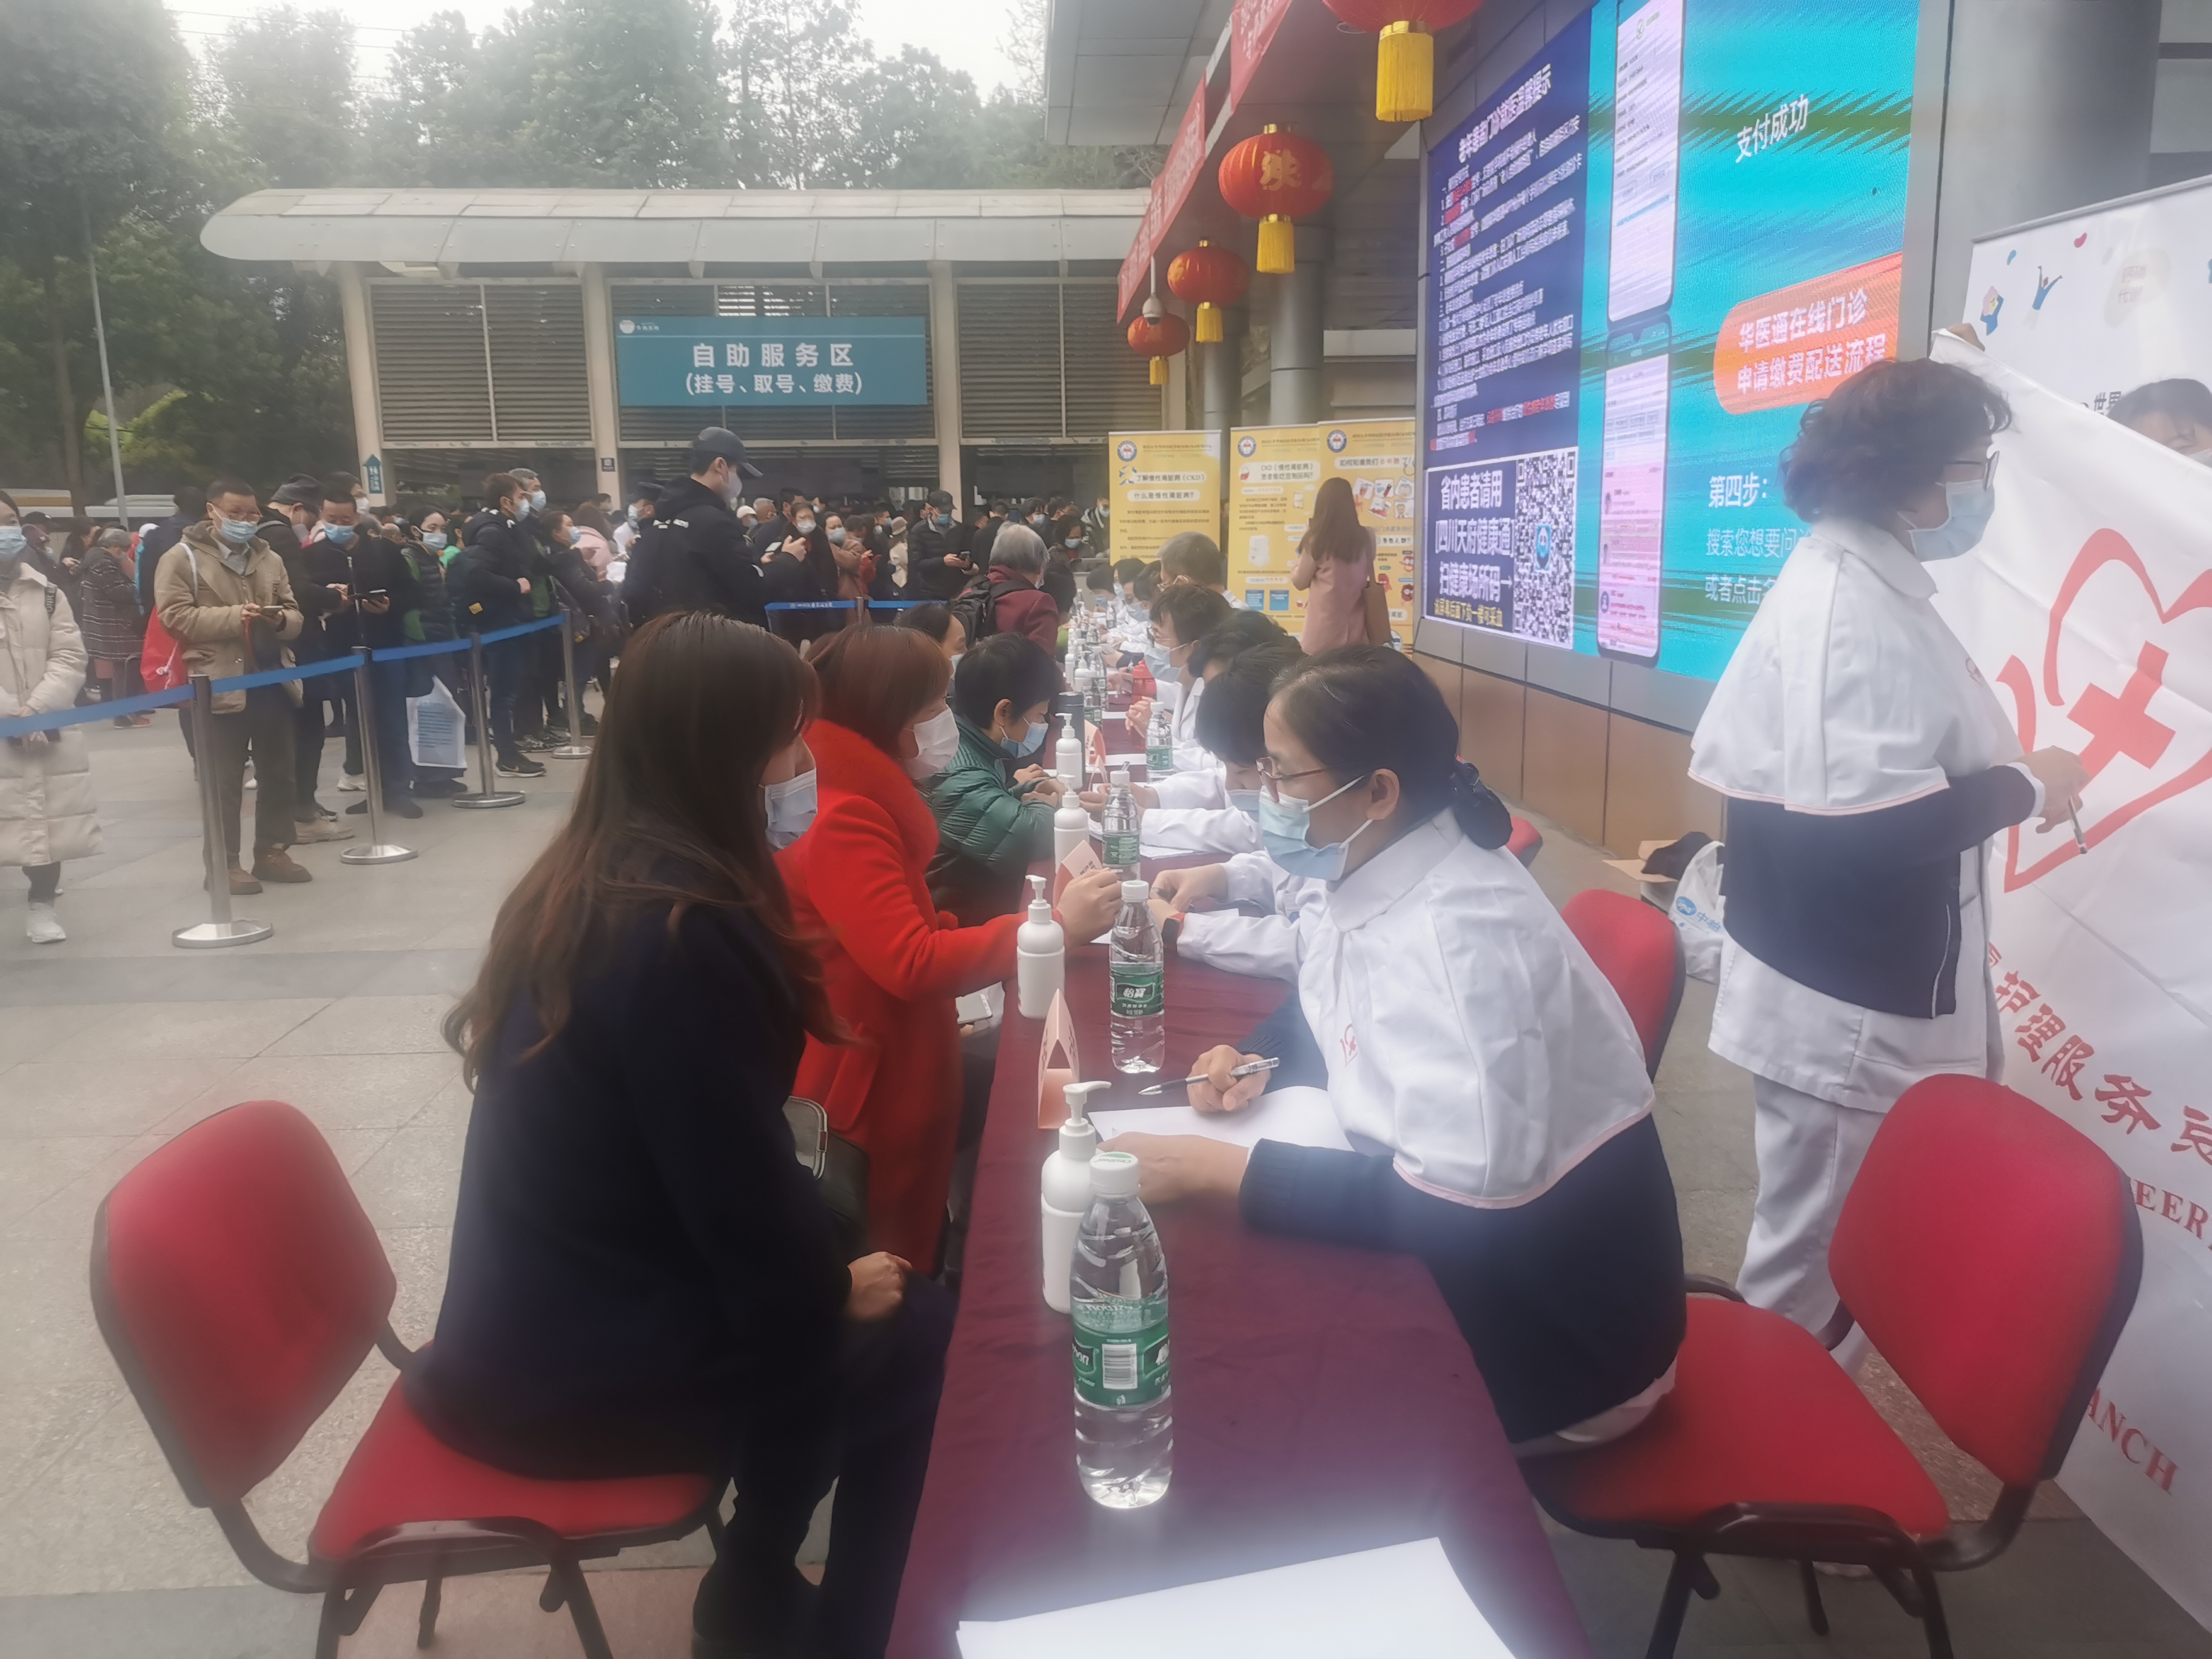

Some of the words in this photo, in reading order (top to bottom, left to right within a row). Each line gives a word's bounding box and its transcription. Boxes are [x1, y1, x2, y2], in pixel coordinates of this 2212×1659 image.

[1735, 94, 1809, 163] 支付成功
[1738, 289, 1868, 354] 华医通在线门诊
[693, 343, 854, 367] 自助服务区
[1441, 470, 1504, 510] 省内患者请用
